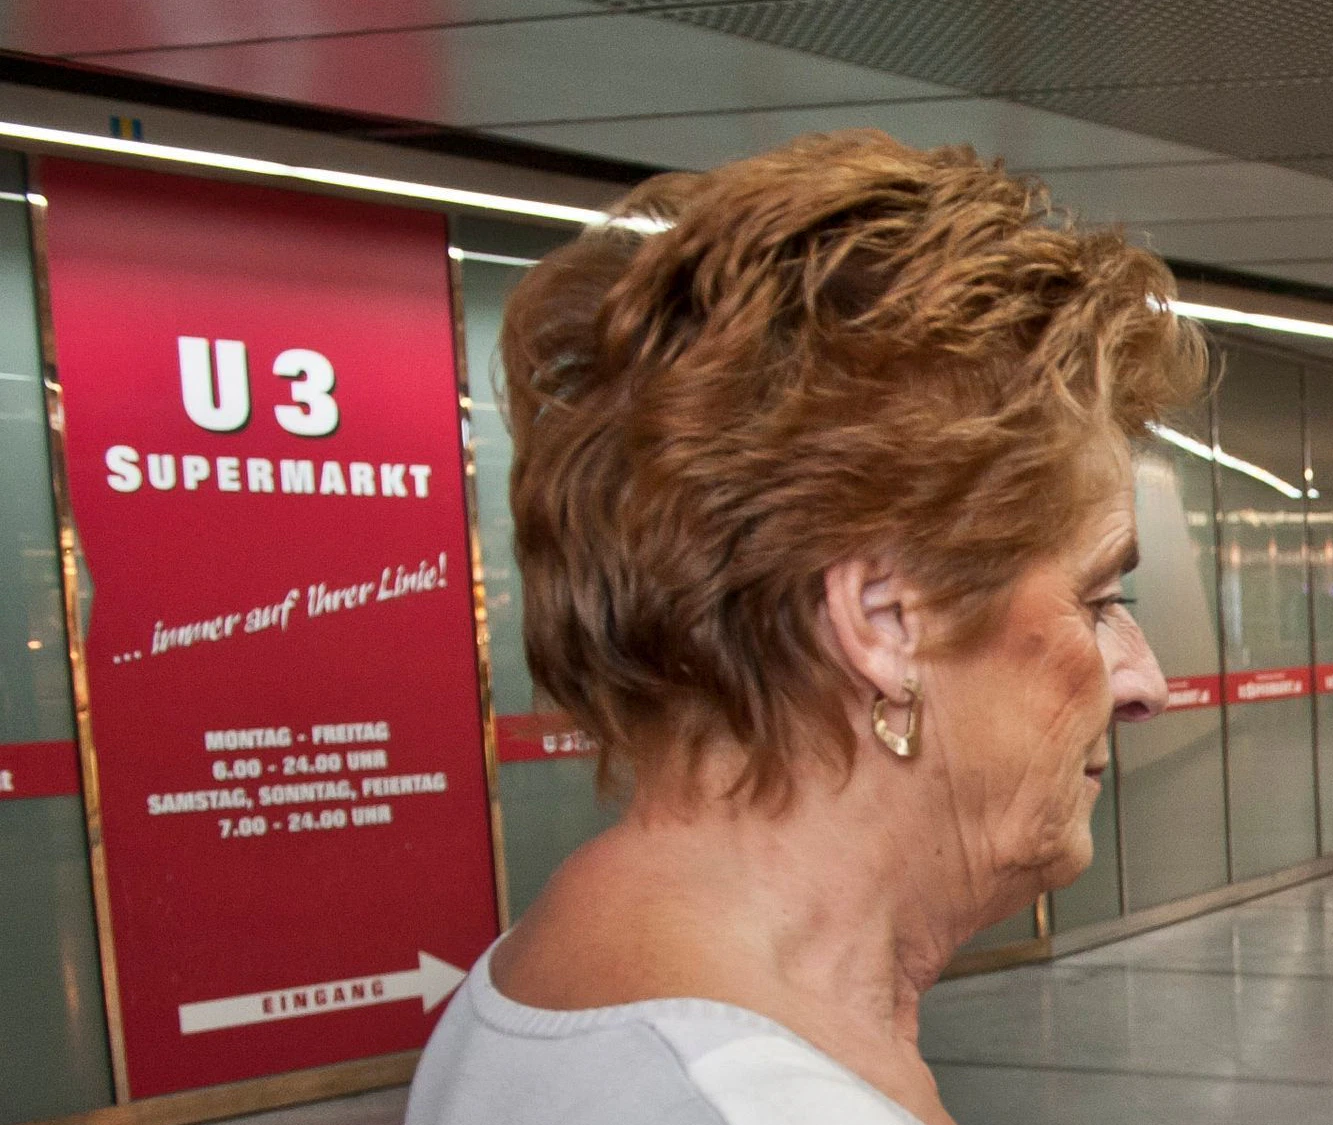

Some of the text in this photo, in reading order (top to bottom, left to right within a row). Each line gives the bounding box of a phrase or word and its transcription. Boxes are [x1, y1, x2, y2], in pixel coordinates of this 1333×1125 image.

[177, 335, 340, 437] U 3
[150, 611, 242, 656] immer
[243, 587, 301, 634] auf
[306, 581, 375, 620] Ihrer
[375, 551, 448, 602] Linie!
[204, 727, 292, 751] MONTAG
[311, 721, 390, 745] FREITAG
[211, 758, 263, 781] 6.00
[281, 753, 343, 776] 24.00
[347, 749, 388, 771] UHR
[147, 772, 447, 815] SAMSTAG, SONNTAG, FEIERTAG
[218, 815, 268, 839] 7.00
[287, 809, 349, 832] 24.00
[351, 804, 392, 826] UHR
[261, 980, 387, 1015] EINGANG
